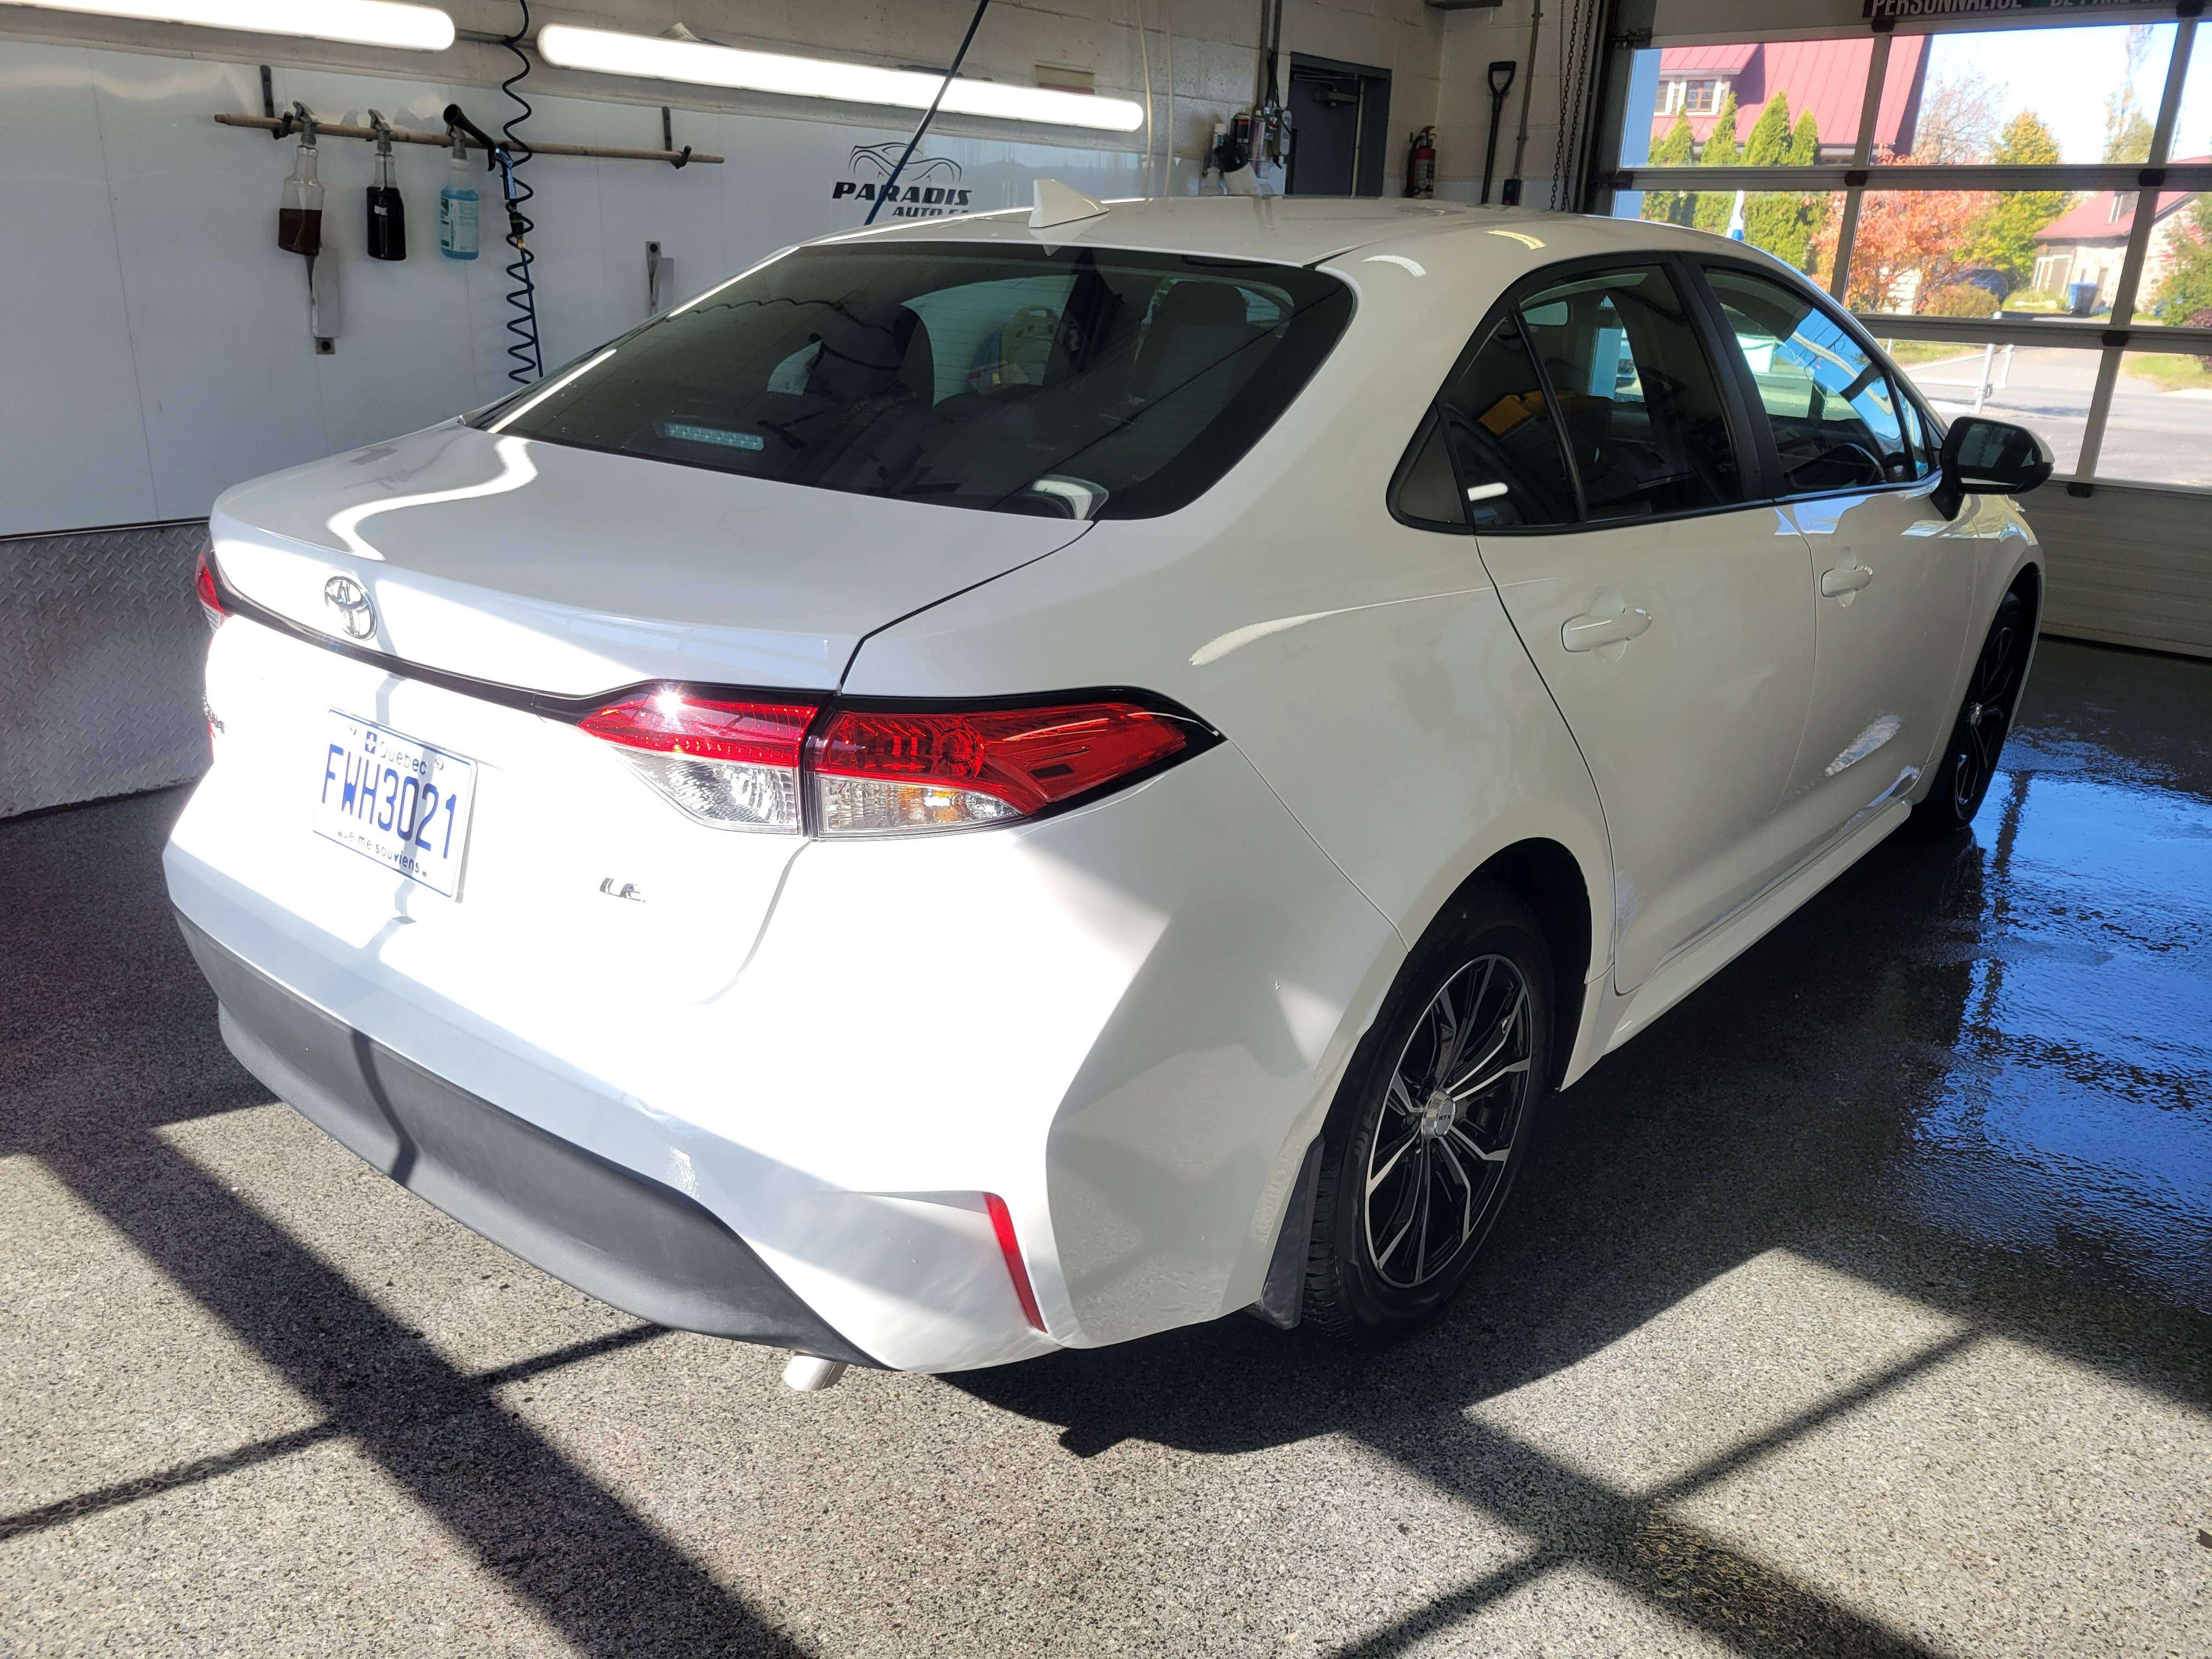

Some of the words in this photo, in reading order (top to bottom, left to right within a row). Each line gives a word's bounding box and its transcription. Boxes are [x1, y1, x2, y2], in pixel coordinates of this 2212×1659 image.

[832, 182, 972, 206] PARADIS
[893, 206, 943, 217] AUTO
[321, 743, 457, 859] FWH3021
[376, 844, 419, 873] souviens
